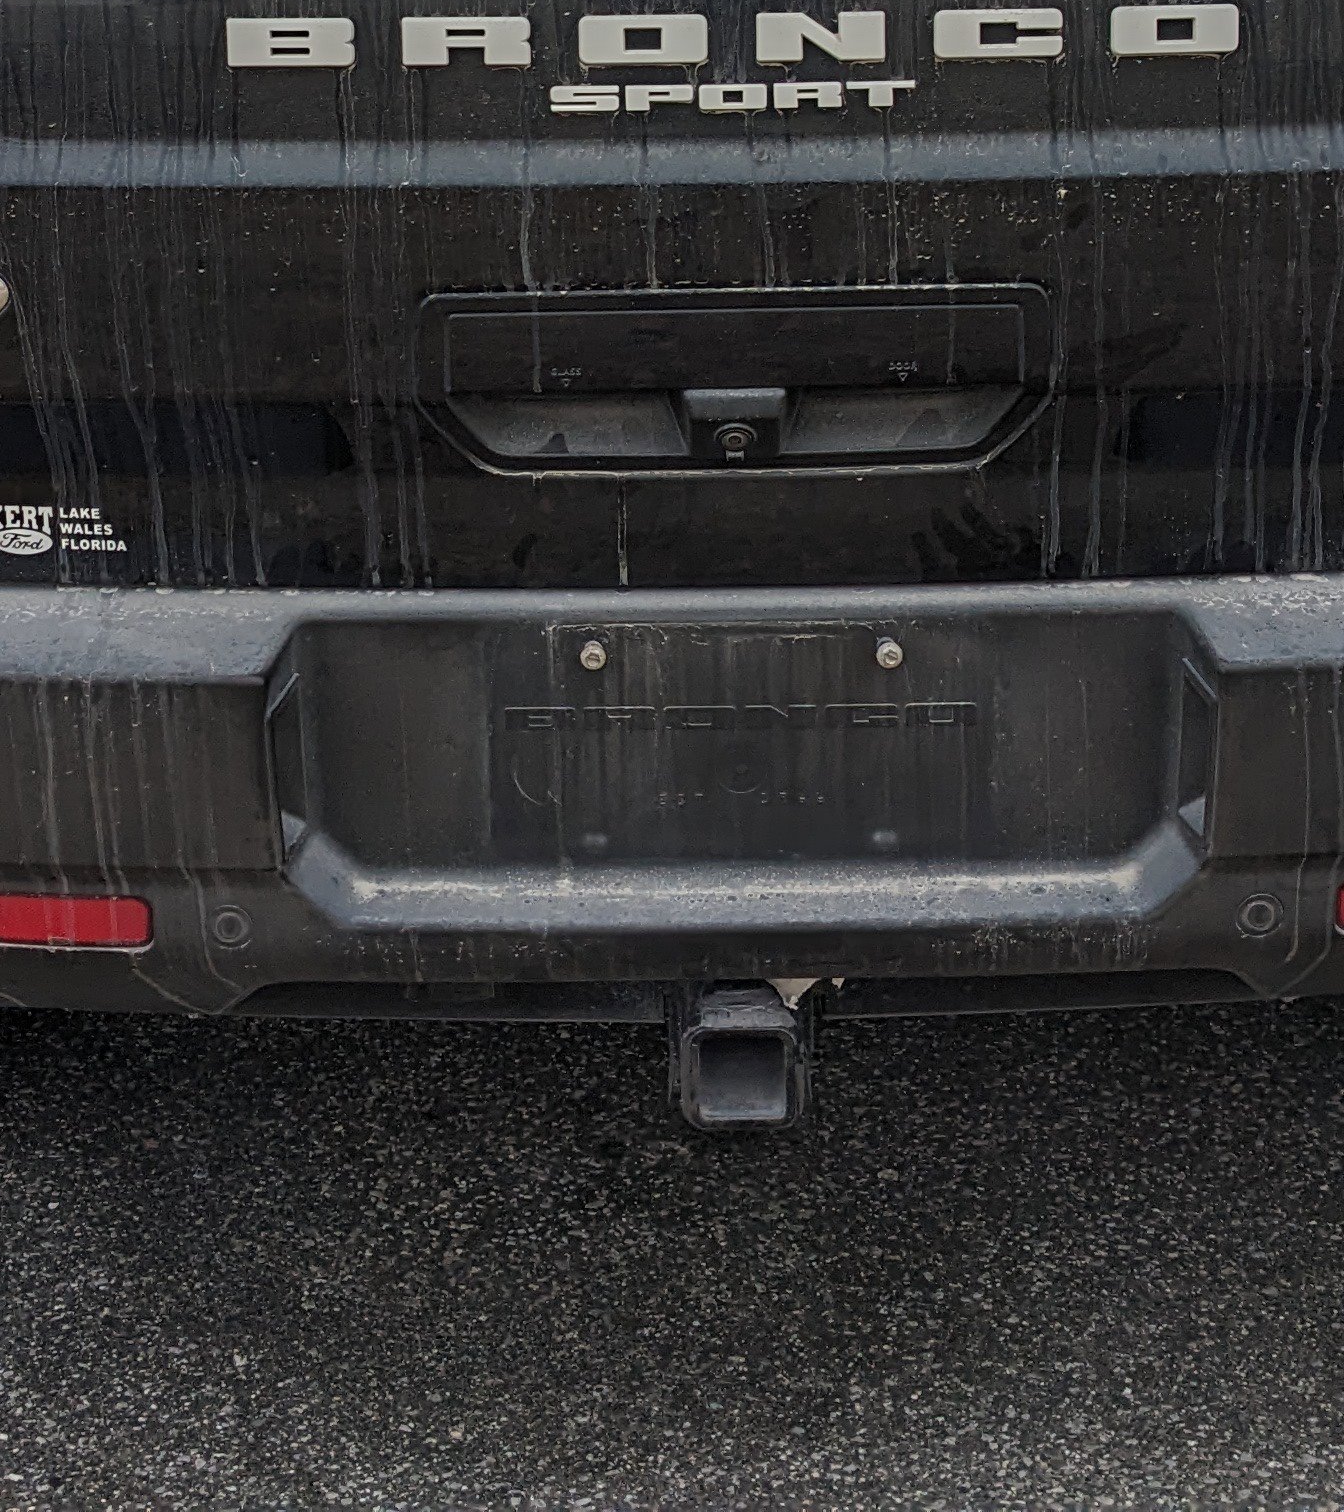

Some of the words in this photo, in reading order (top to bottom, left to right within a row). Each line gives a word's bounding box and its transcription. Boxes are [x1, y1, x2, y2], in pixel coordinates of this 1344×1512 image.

[226, 2, 1241, 69] BRONCO
[549, 79, 916, 114] SPORT
[59, 507, 101, 520] LAKE
[60, 522, 114, 536] WALES
[0, 532, 44, 551] Ford
[61, 538, 128, 552] FLORIDA
